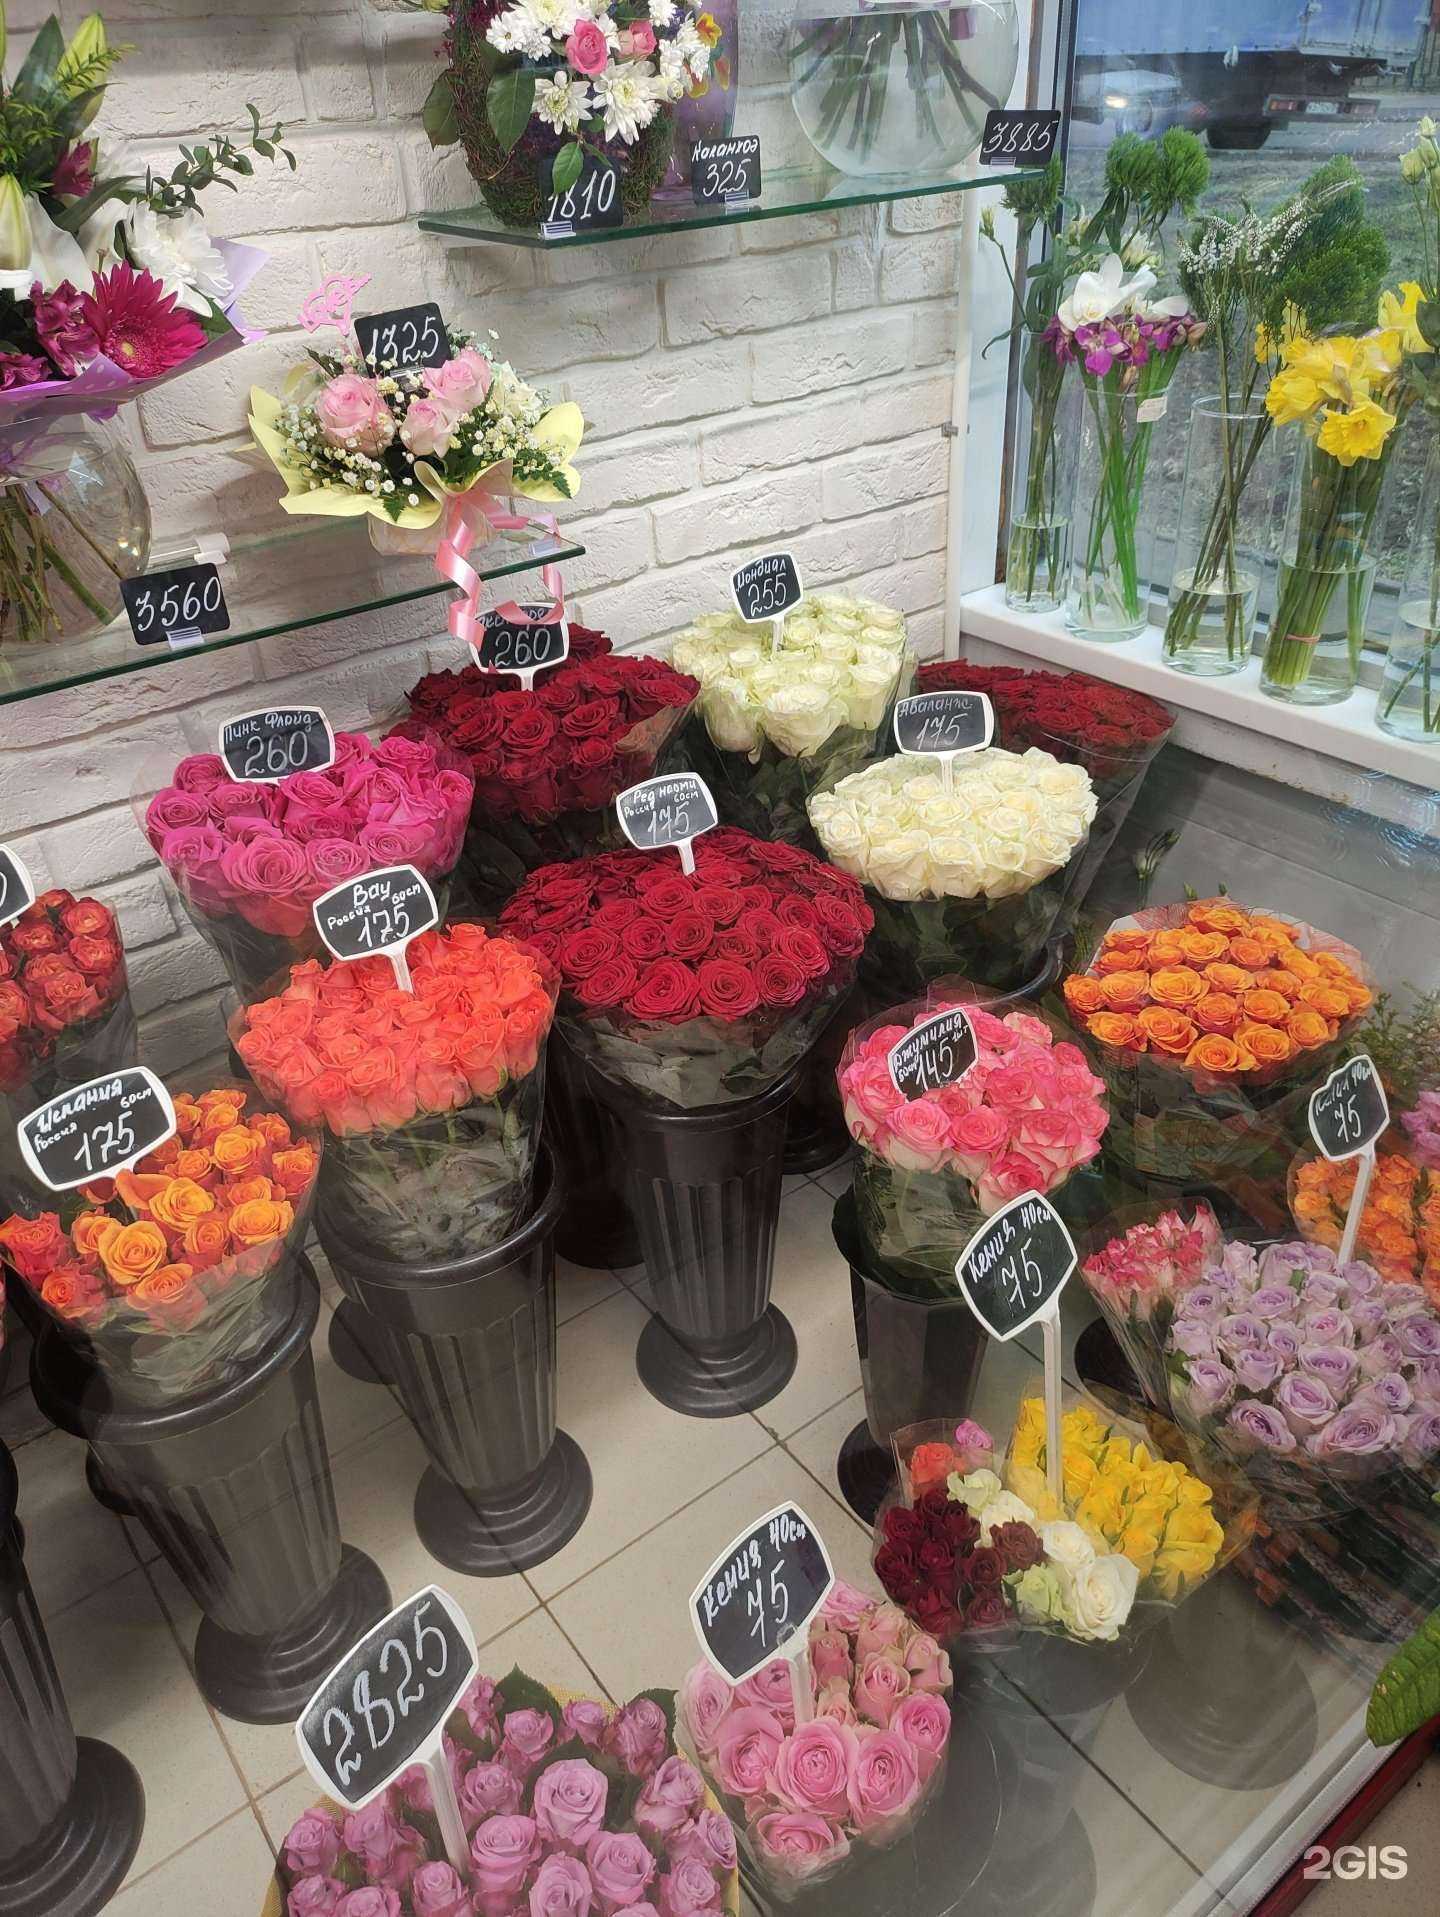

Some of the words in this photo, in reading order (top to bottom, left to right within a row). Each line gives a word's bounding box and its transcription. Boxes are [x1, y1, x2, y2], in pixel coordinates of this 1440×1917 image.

[983, 120, 1059, 153] 3885
[703, 158, 752, 197] 325
[368, 315, 439, 364] 1325
[135, 576, 221, 632] 3560
[747, 572, 787, 617] 255
[494, 628, 551, 668] 260
[224, 720, 261, 745] Пинк
[264, 710, 320, 733] Флойд
[916, 713, 969, 750] 175
[244, 730, 308, 777] 260
[647, 801, 690, 844] 175
[353, 880, 391, 908] Вау
[357, 902, 410, 948] 175
[915, 1037, 953, 1092] 145
[73, 1110, 136, 1171] 175
[1334, 1094, 1362, 1143] 75
[1001, 1237, 1043, 1309] 75
[747, 1559, 789, 1648] 75
[323, 1600, 448, 1786] 2825
